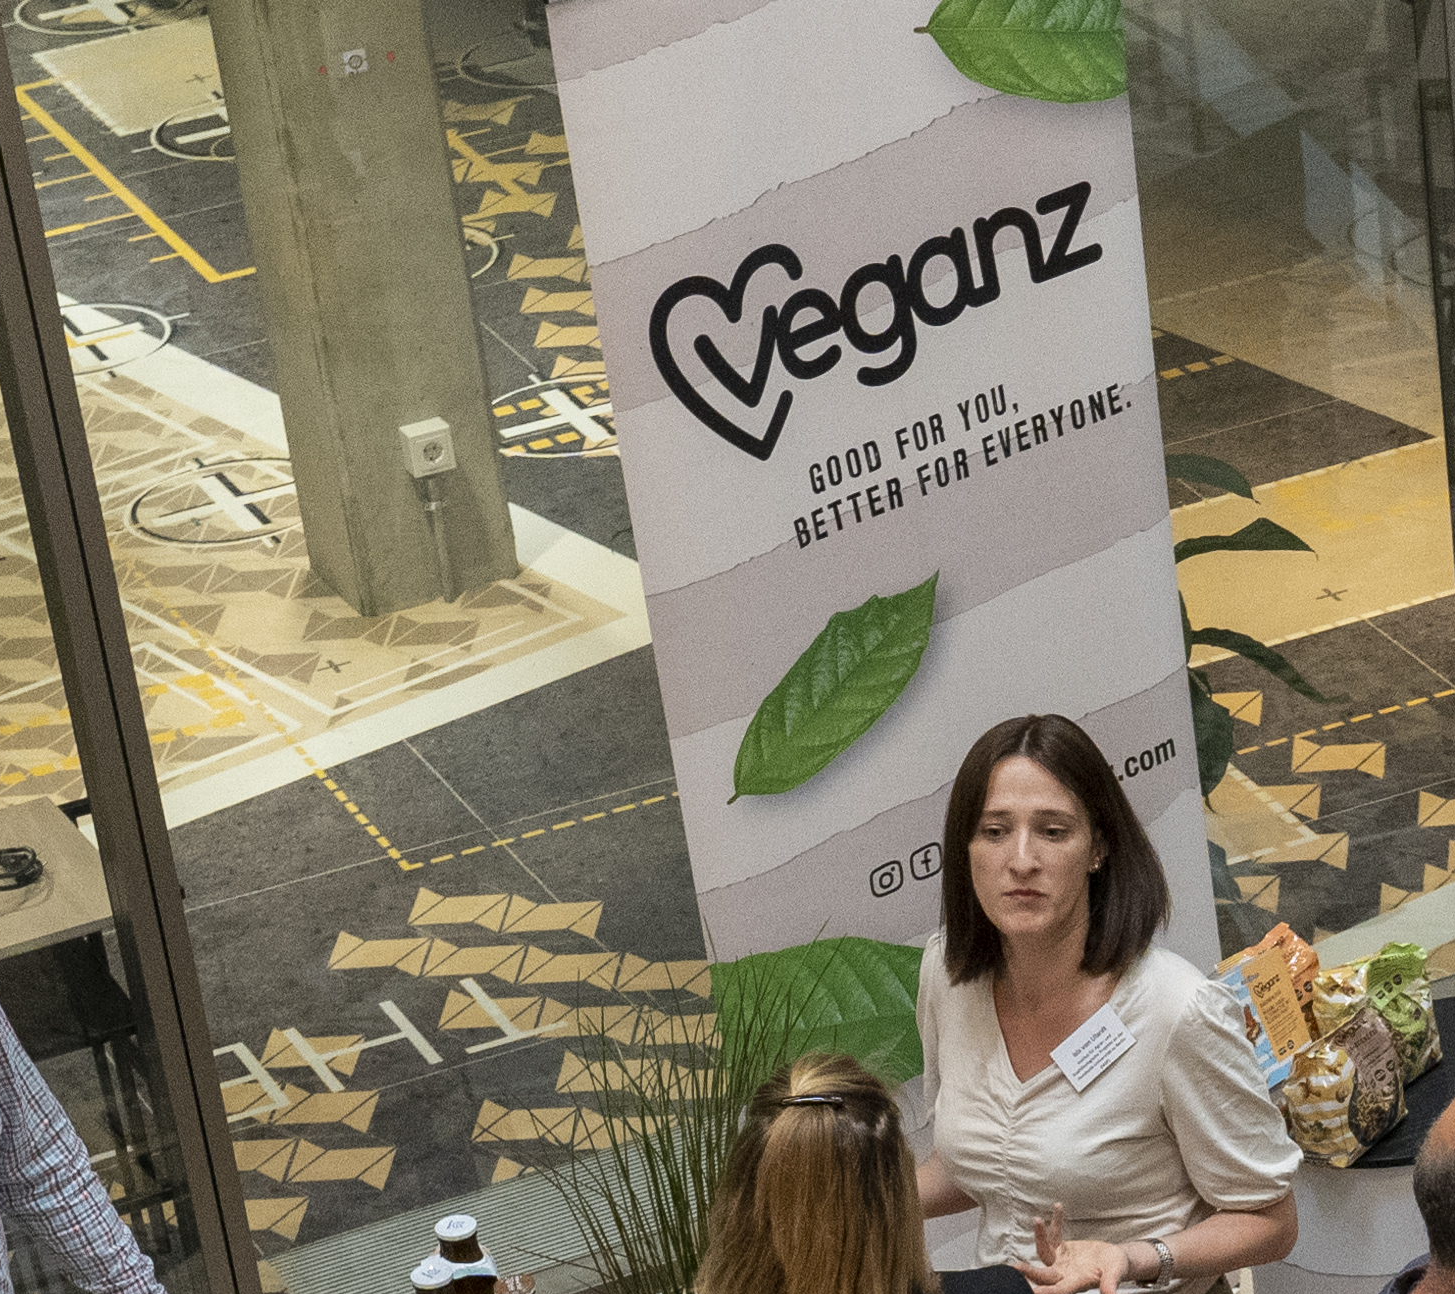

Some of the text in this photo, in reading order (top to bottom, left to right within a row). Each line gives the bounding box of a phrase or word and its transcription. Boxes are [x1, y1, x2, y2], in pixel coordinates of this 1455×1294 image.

[648, 180, 1104, 461] Veganz
[792, 381, 1134, 549] BETTER FOR EVERYONE.
[807, 384, 1020, 497] GOOD FOR YOU,
